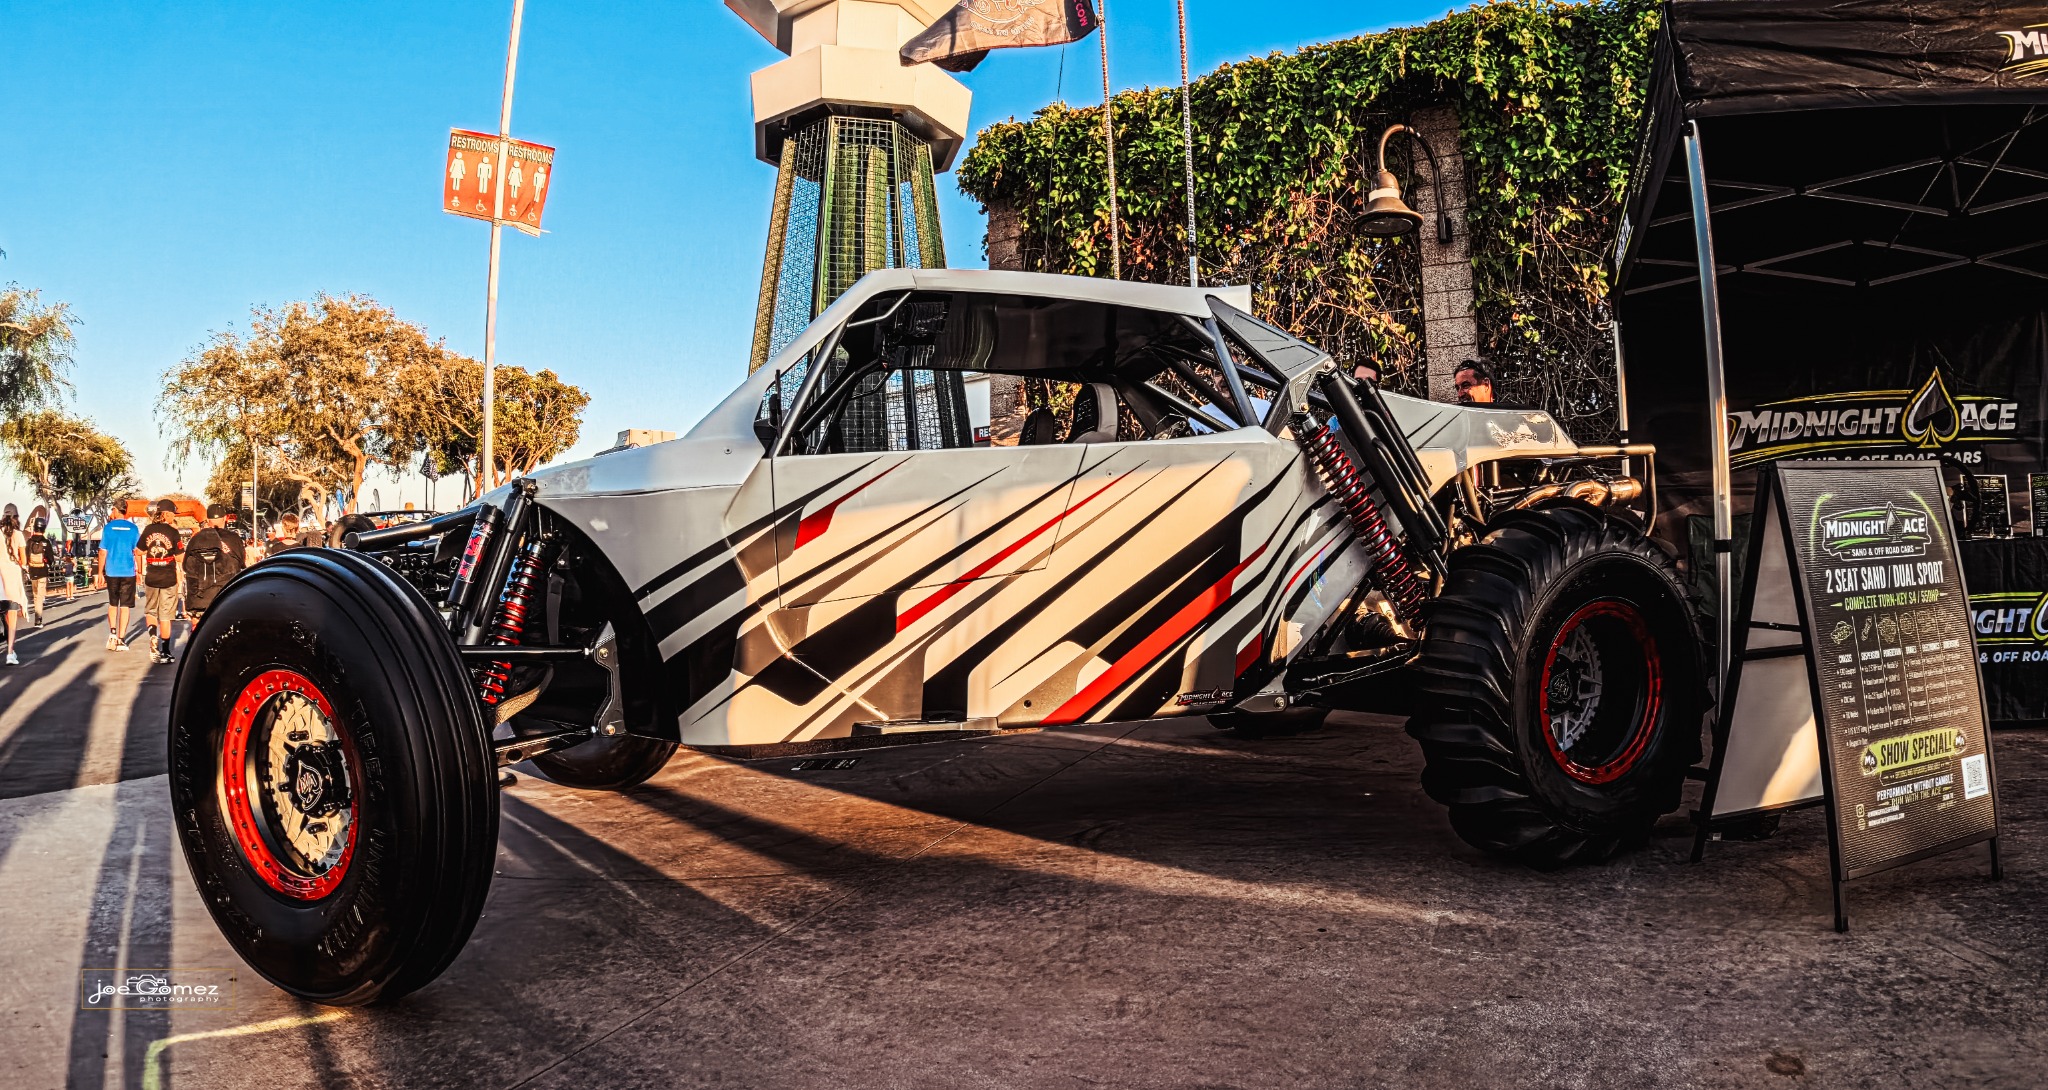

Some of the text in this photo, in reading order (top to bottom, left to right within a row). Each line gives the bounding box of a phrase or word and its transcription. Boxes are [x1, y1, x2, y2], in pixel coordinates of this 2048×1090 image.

[451, 136, 499, 154] RESTROOMS
[508, 145, 553, 165] RESTROOMS
[1729, 402, 2018, 450] MIDNIGHT ACE
[1825, 517, 1926, 539] MIDNIGHT ACE
[1852, 548, 1867, 557] SAND
[1875, 547, 1884, 556] OFF
[1886, 546, 1899, 554] ROAD
[1901, 545, 1914, 553] CARS
[1826, 569, 1833, 594] 2
[1835, 567, 1858, 593] SEAT
[1861, 565, 1886, 591] SAND
[1893, 563, 1916, 588] DUAL
[1917, 561, 1944, 585] SPORT
[1844, 595, 1878, 611] COMPLETE
[1878, 591, 1907, 607] TURN-KEY
[1980, 652, 1988, 663] &
[1993, 651, 2019, 663] OFF
[1880, 731, 1952, 767] SHOW SPECIAL!
[1876, 784, 1913, 801] PERFORMANCE
